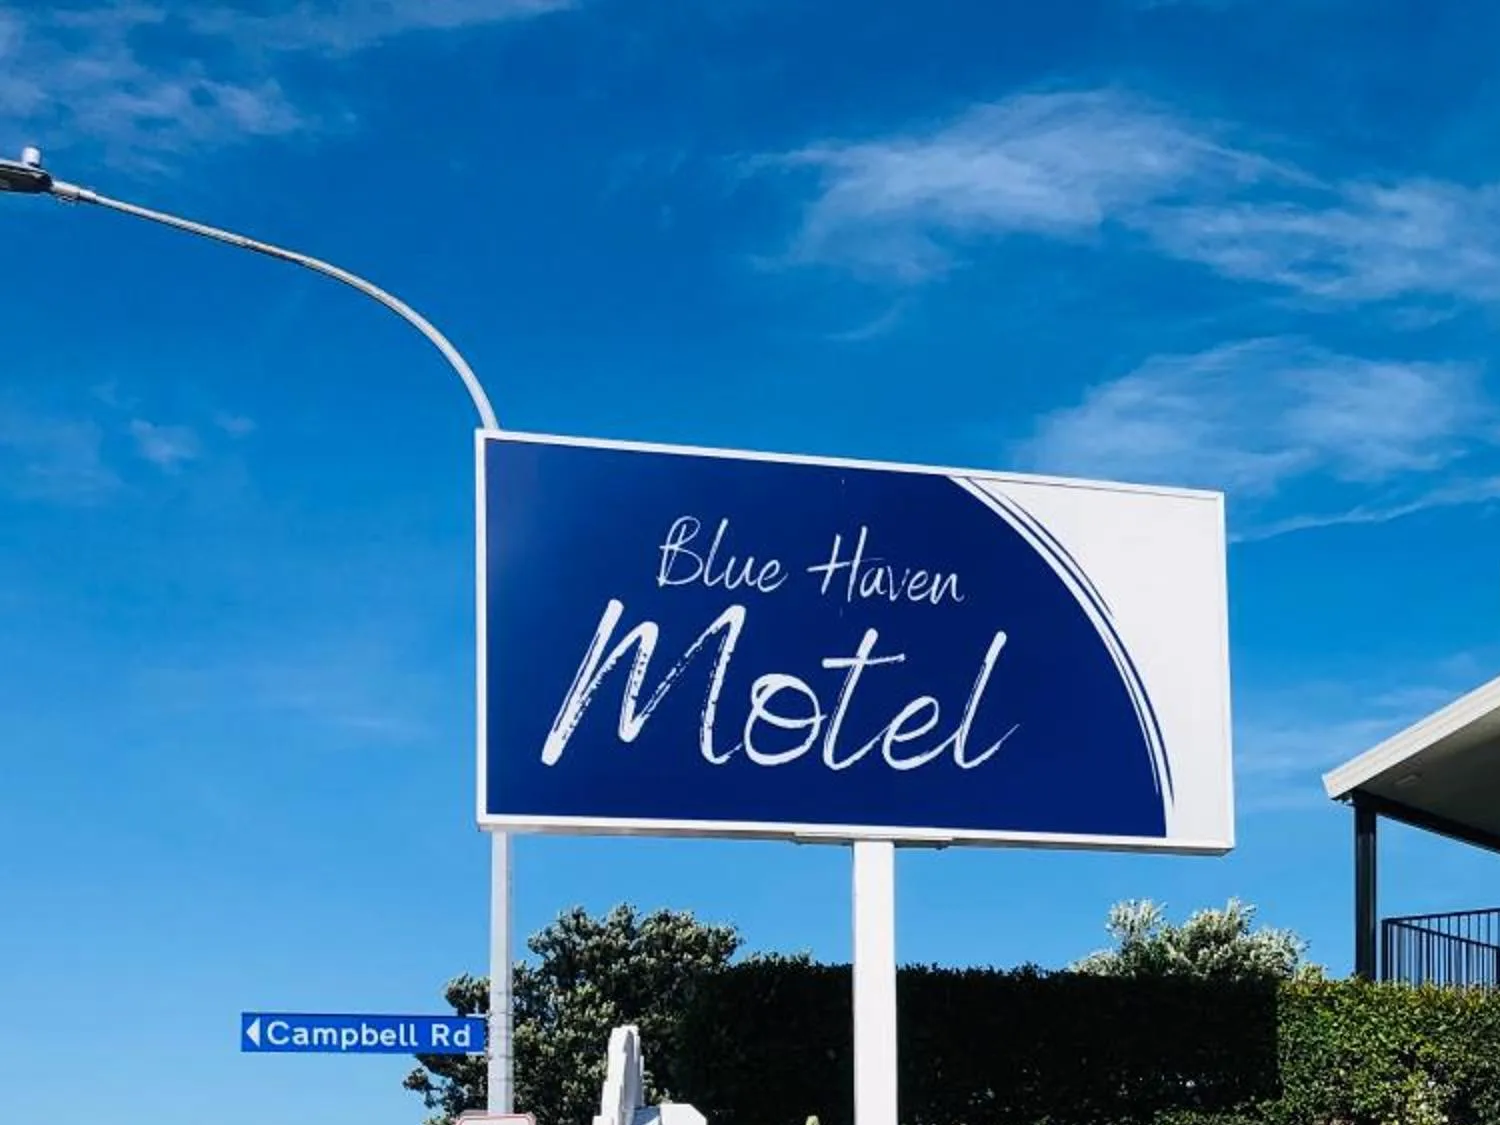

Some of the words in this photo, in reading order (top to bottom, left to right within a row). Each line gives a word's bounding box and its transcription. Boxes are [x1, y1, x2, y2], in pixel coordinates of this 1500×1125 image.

[656, 515, 789, 590] Blue
[808, 526, 966, 603] Haven
[541, 598, 1020, 771] Motel
[266, 1021, 418, 1050] Campbell
[430, 1023, 471, 1047] Rd
